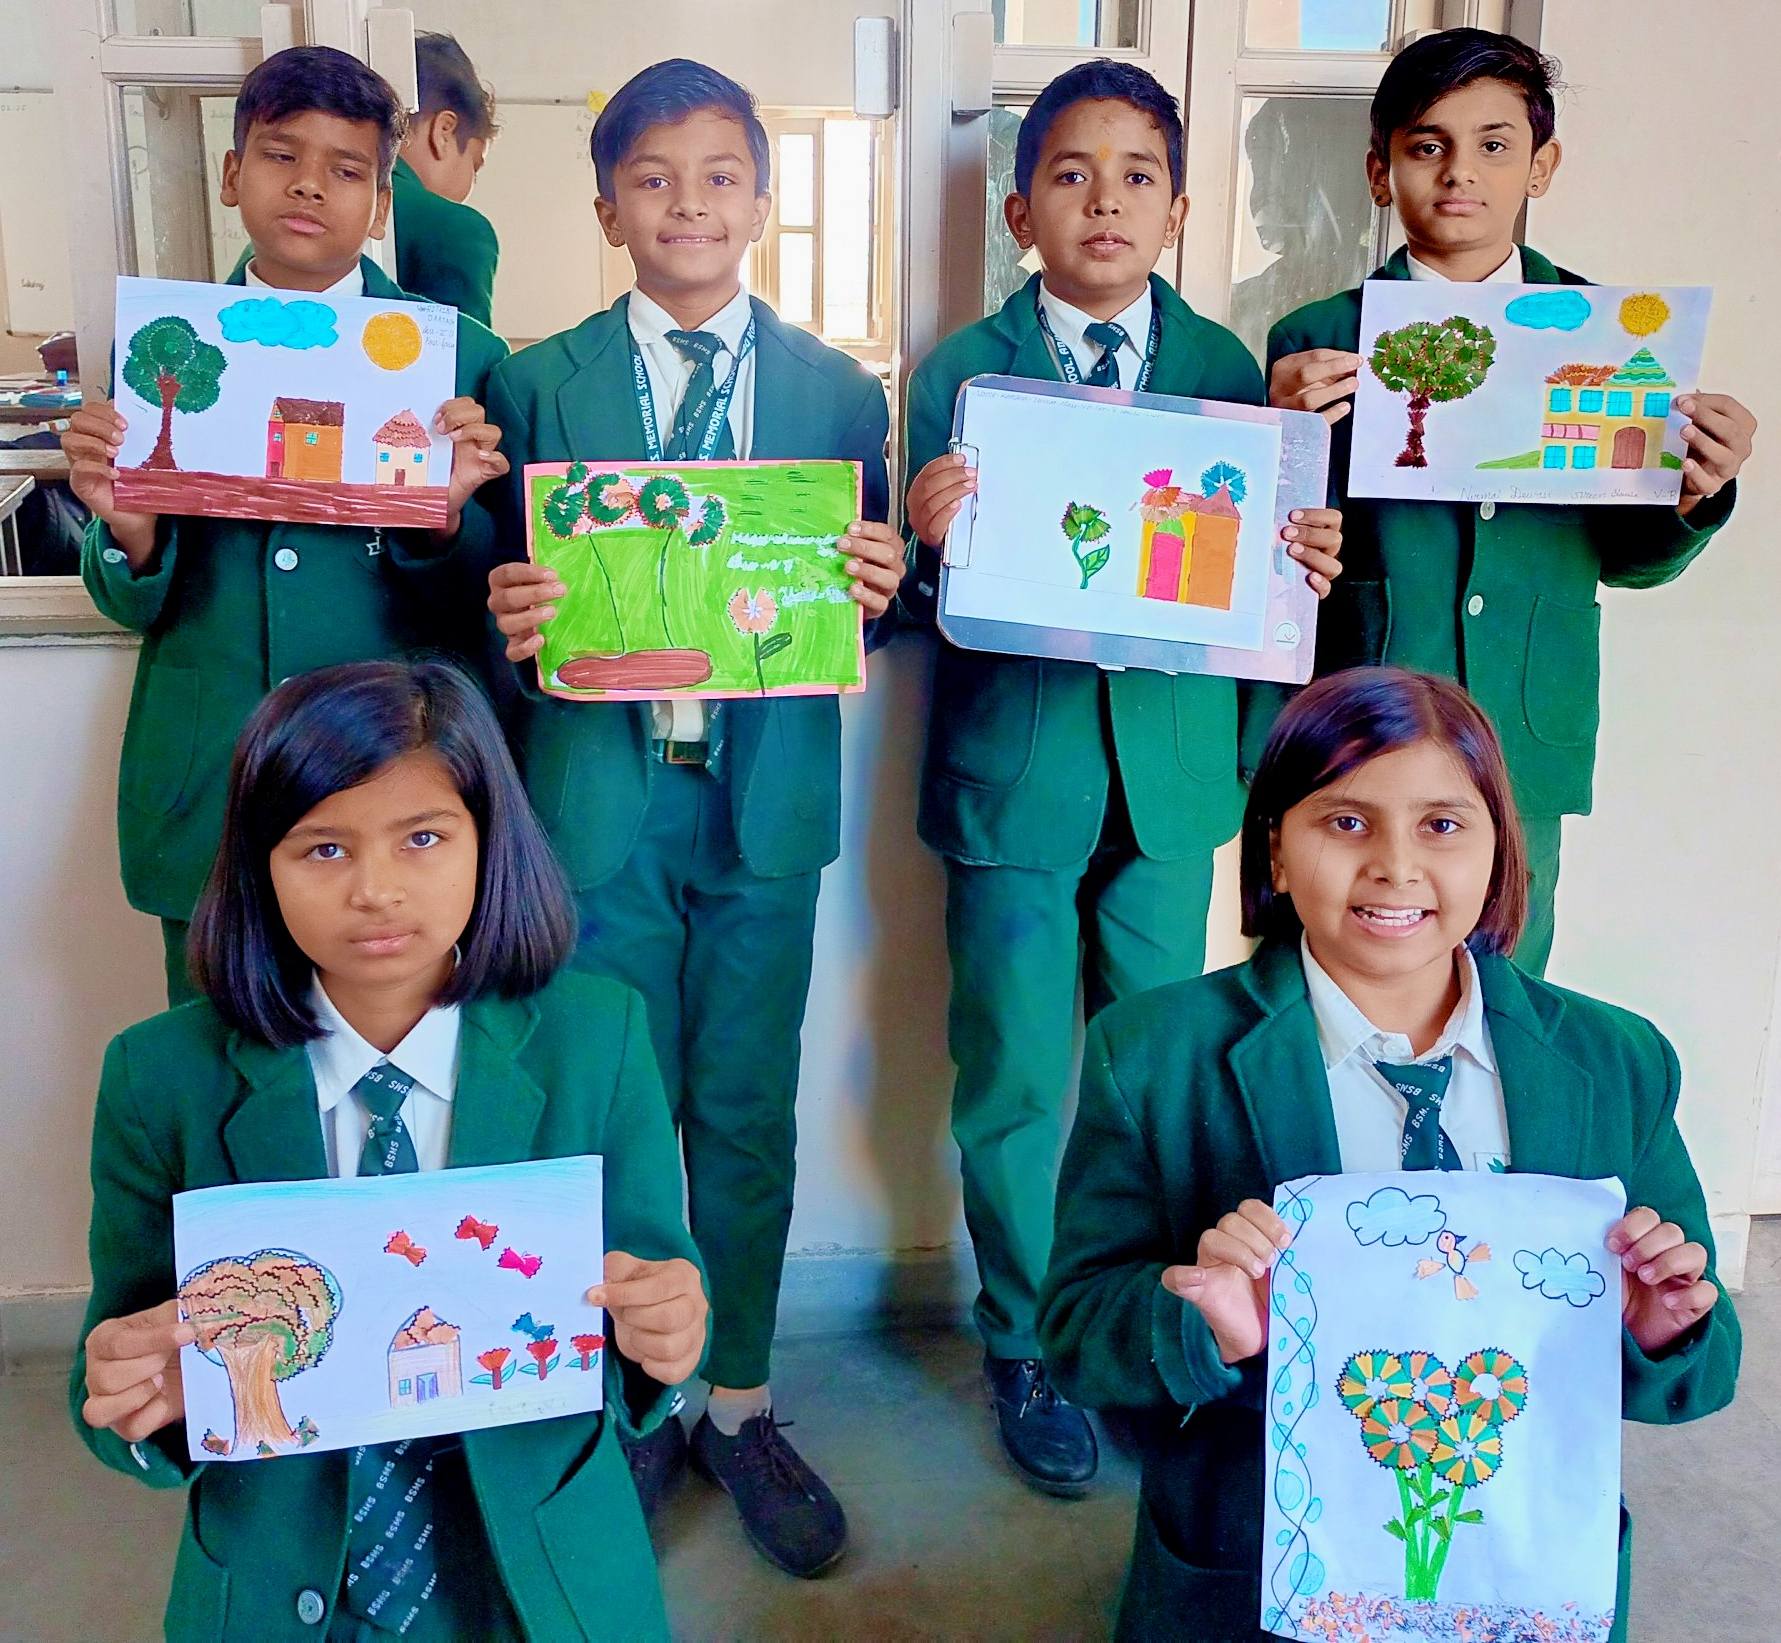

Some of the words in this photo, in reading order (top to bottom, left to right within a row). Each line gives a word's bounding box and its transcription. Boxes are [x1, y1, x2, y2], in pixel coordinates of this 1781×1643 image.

[633, 354, 648, 391] SCHOOL
[639, 393, 658, 450] MEMORIAL
[693, 399, 707, 418] BSMS
[702, 397, 728, 452] MEMORIAL
[1395, 1083, 1423, 1096] BSMS
[1411, 1107, 1430, 1129] BSM
[384, 1140, 400, 1169] BSMS
[353, 1495, 376, 1522] BSMS
[376, 1460, 396, 1490] BSMS
[360, 1544, 385, 1569] BSMS
[385, 1510, 406, 1539] BSMS
[404, 1477, 426, 1503] BSMS
[366, 1589, 391, 1616] BSMS
[413, 1523, 434, 1551] BSMS
[399, 1606, 420, 1633] BSMS
